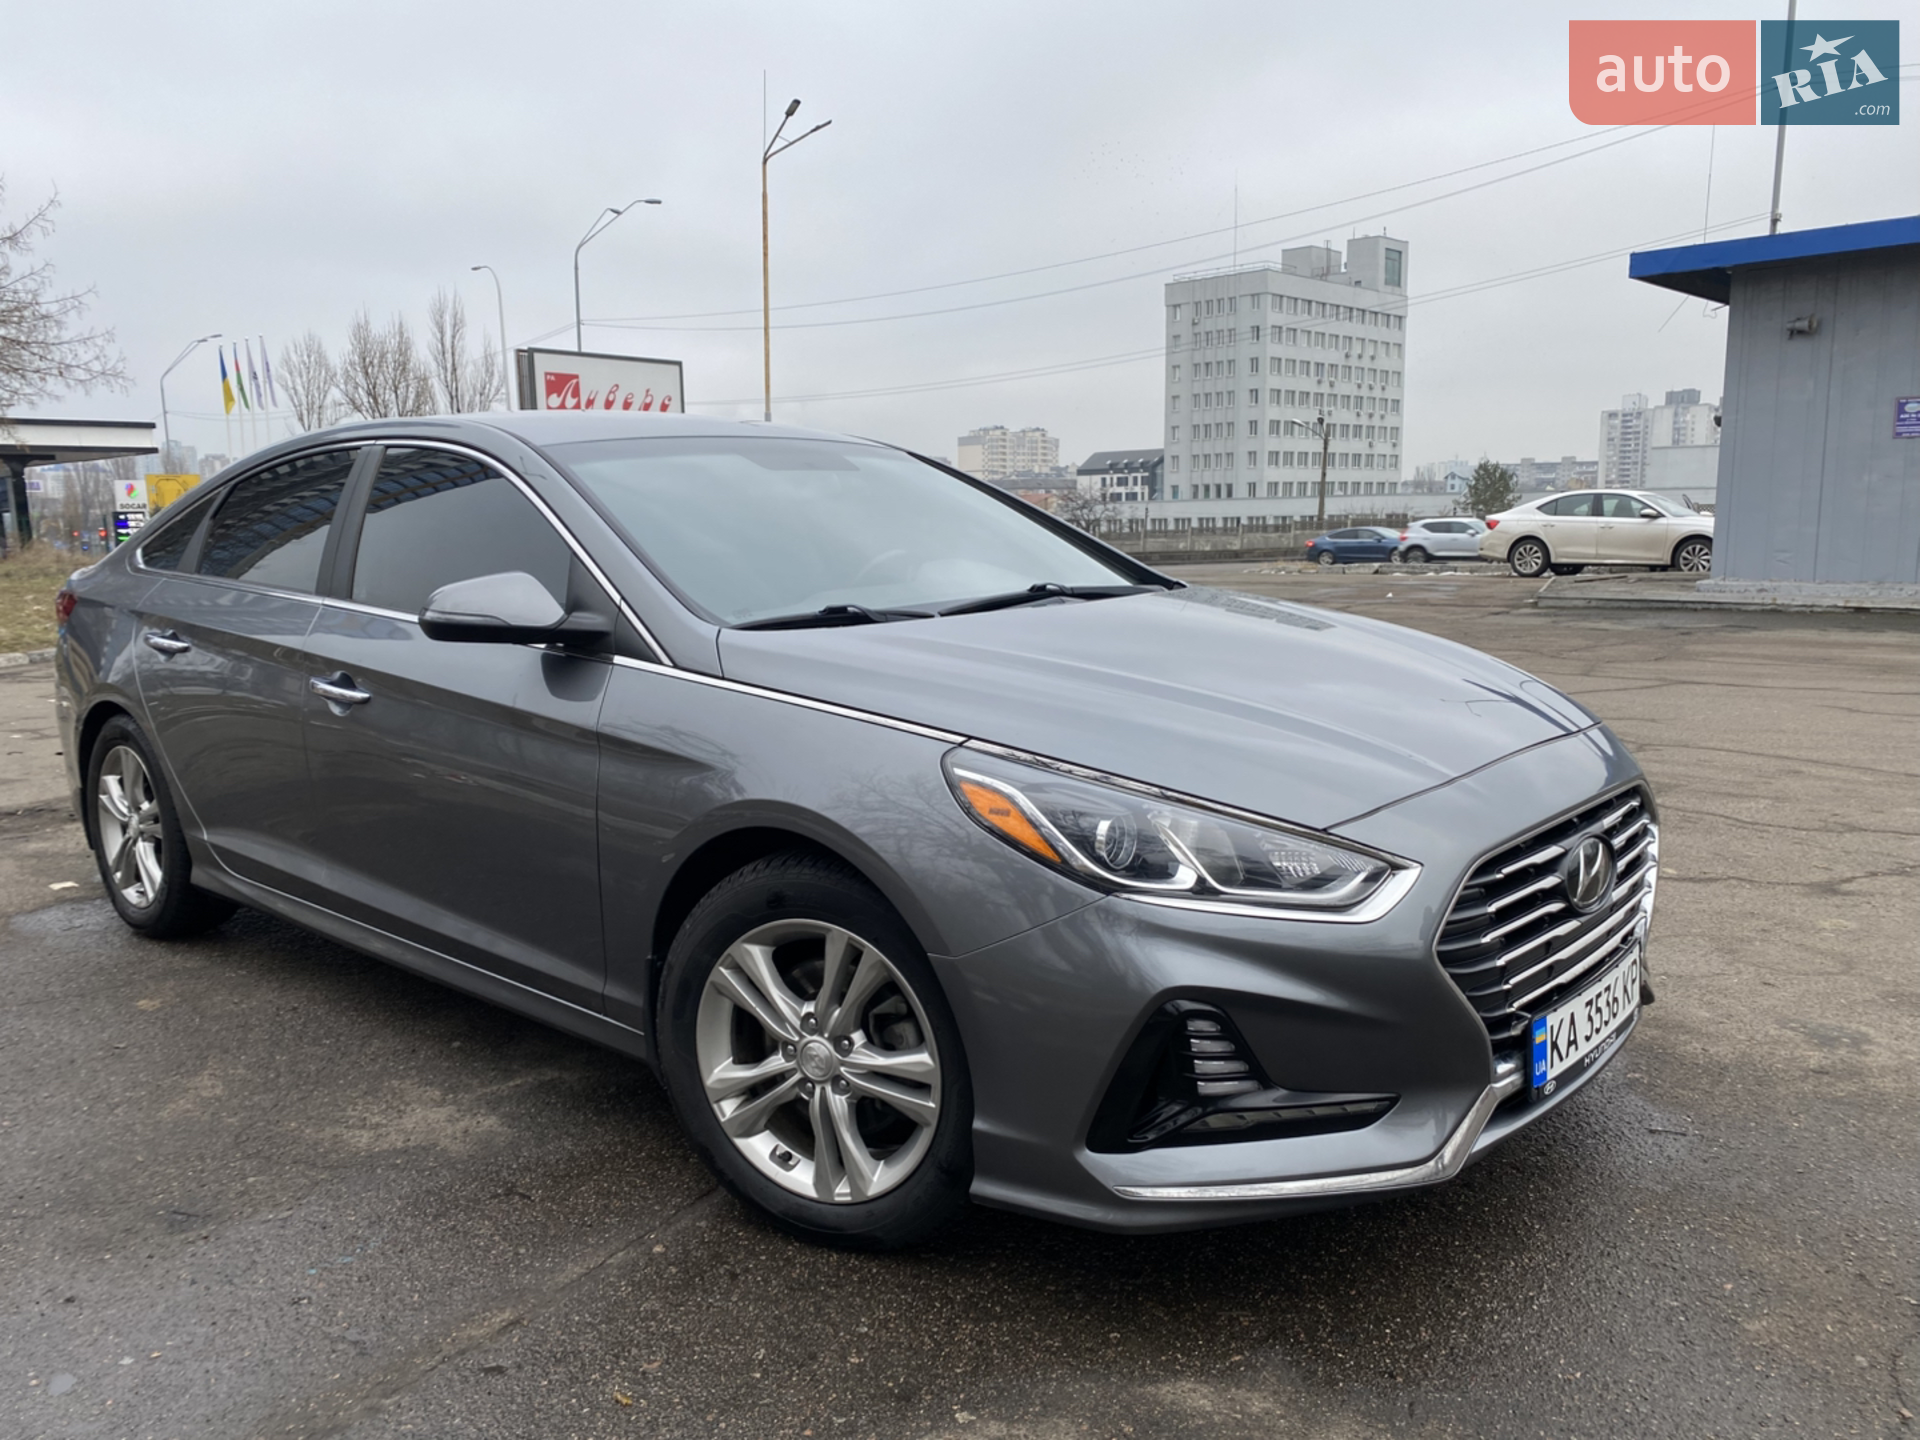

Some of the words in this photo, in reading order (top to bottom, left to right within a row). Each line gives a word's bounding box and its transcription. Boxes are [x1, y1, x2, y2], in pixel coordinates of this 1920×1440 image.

[119, 502, 147, 510] SOCAR
[1550, 1011, 1579, 1069] KA
[1584, 975, 1619, 1043] 3536
[1621, 957, 1637, 1011] KP
[1535, 1058, 1547, 1076] UA
